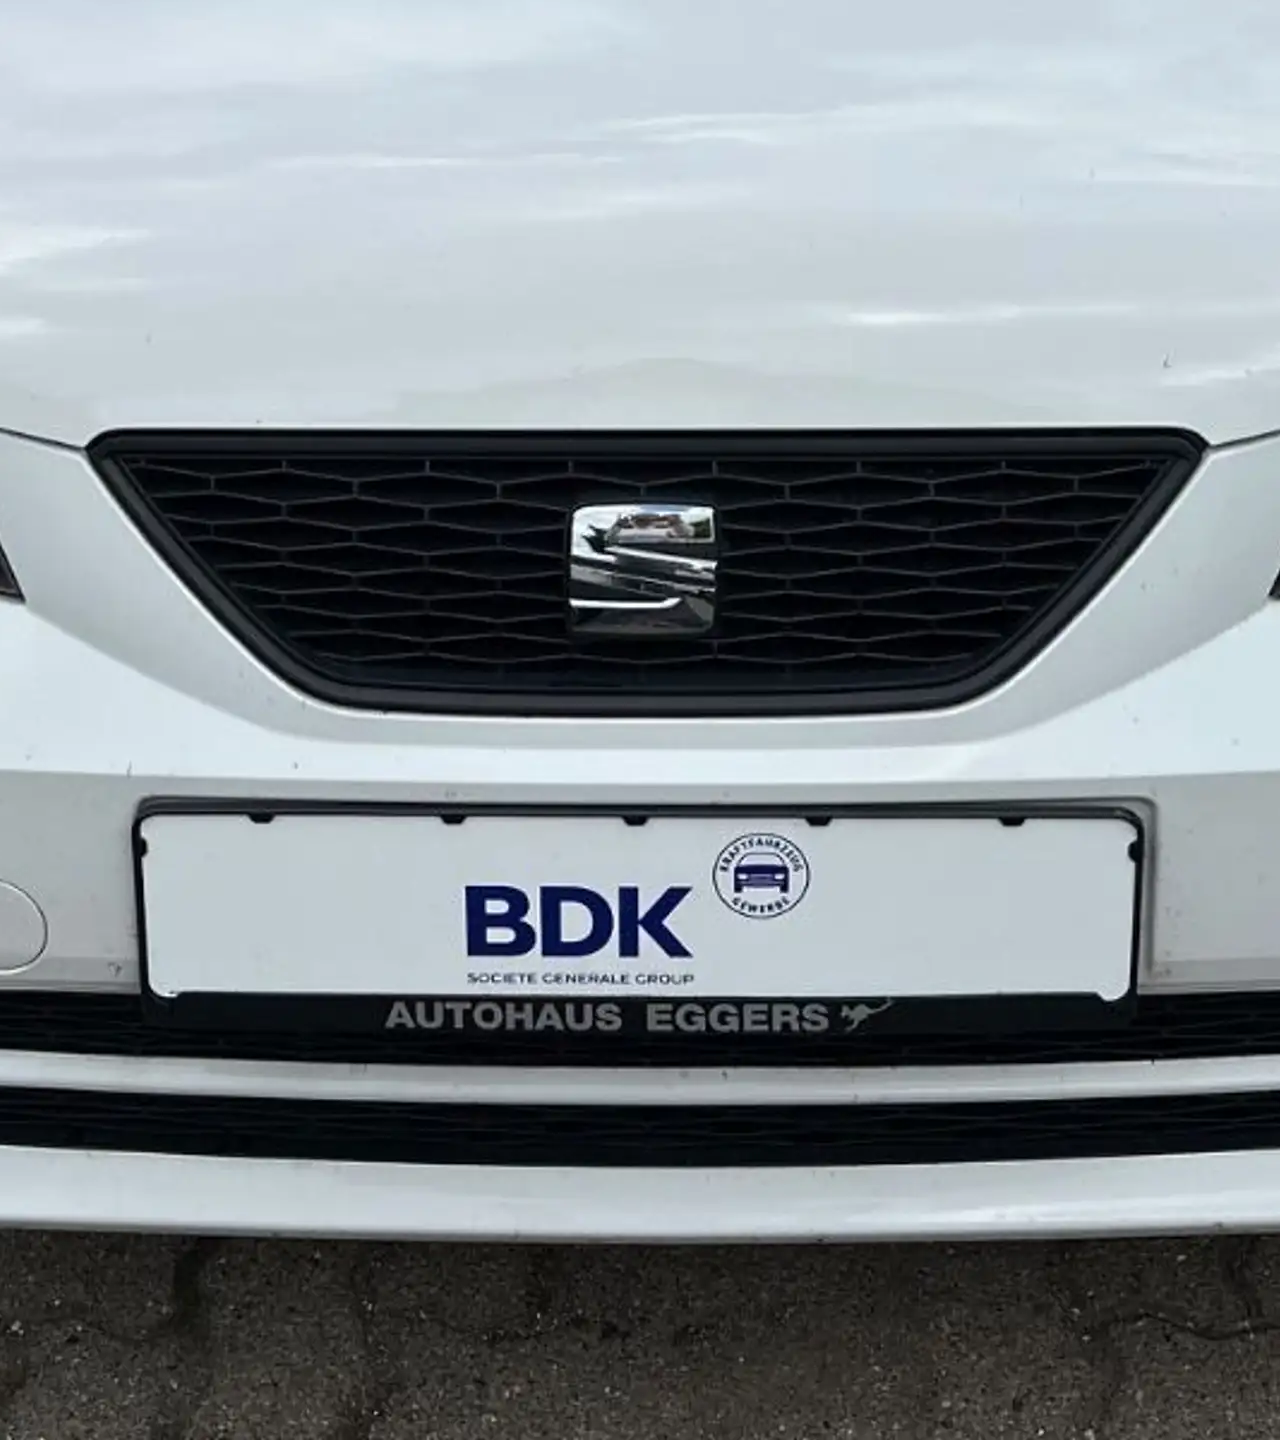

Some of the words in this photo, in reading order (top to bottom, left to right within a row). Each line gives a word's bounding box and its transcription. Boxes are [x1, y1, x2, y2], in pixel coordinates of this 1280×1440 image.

[465, 885, 694, 958] BDK
[467, 972, 538, 984] SOCIETE
[543, 972, 630, 985] GENERALE
[635, 973, 694, 985] GROUP
[385, 1000, 623, 1031] AUTOHAUS
[646, 1002, 829, 1033] EGGERS
